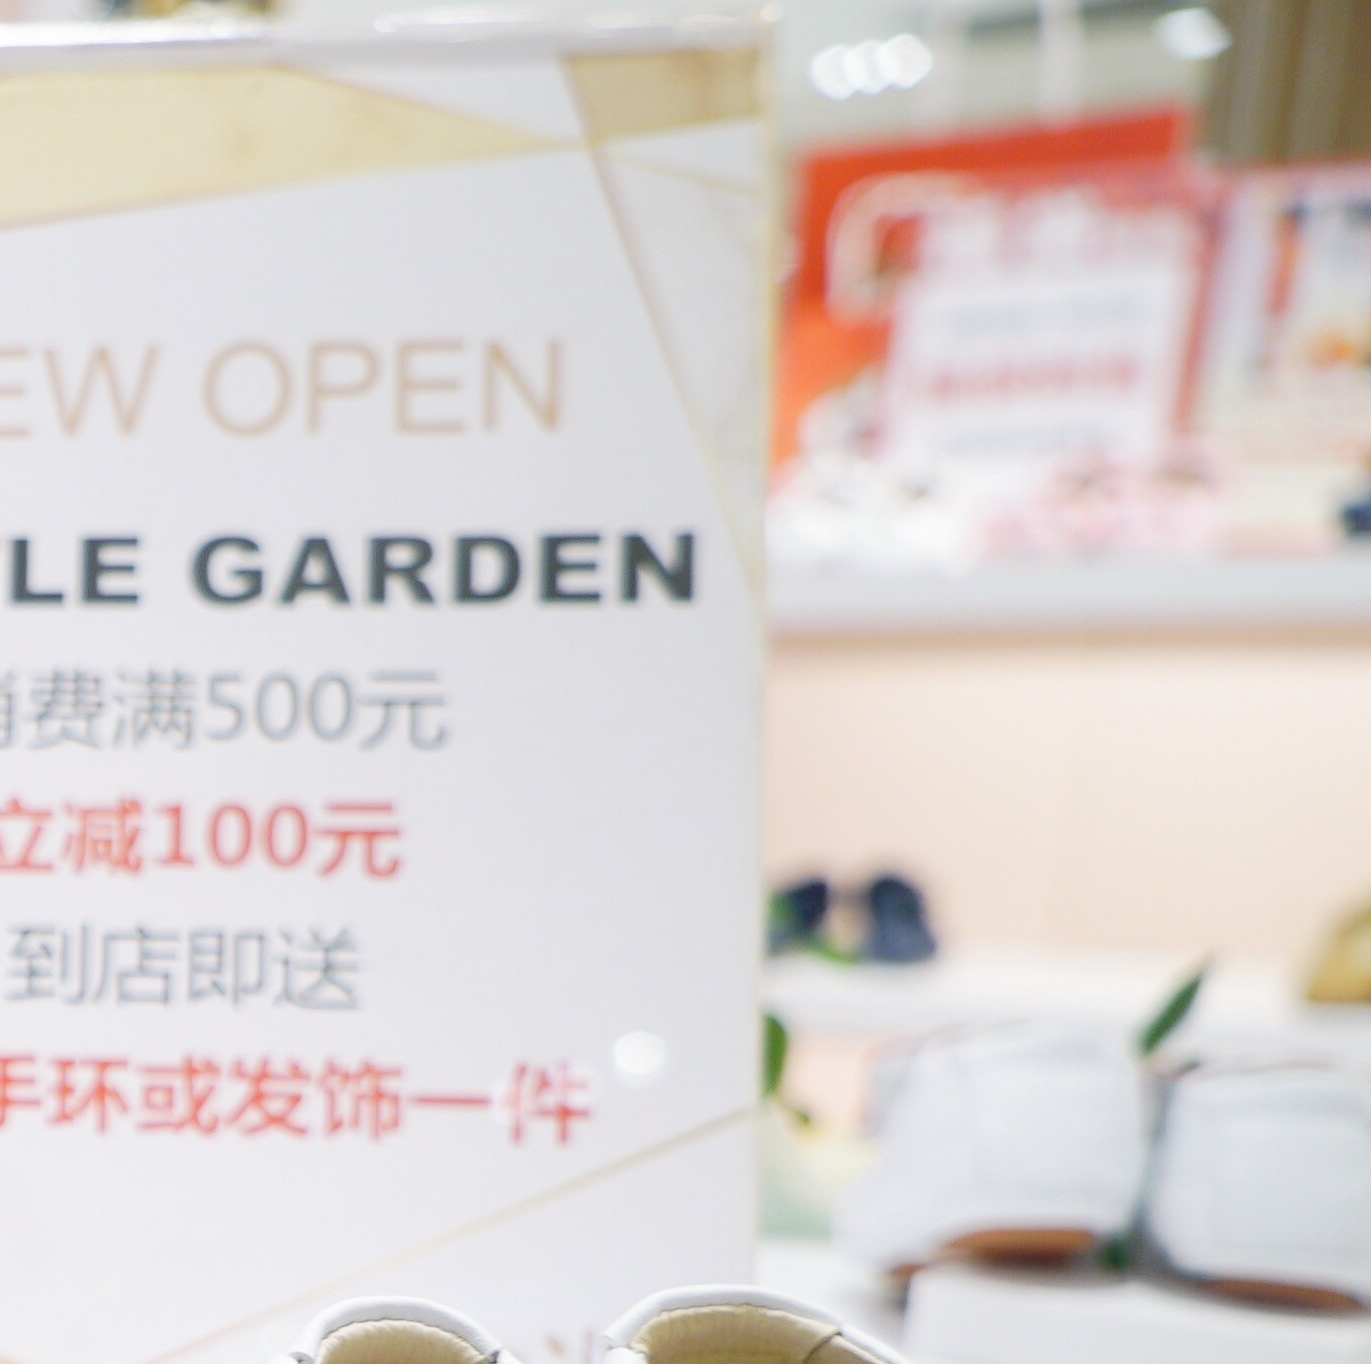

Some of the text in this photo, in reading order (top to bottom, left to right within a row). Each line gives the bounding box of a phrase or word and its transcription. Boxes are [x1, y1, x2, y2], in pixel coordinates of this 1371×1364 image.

[202, 338, 565, 436] OPEN
[189, 531, 698, 608] GARDEN
[5, 923, 361, 1011] 到店即送
